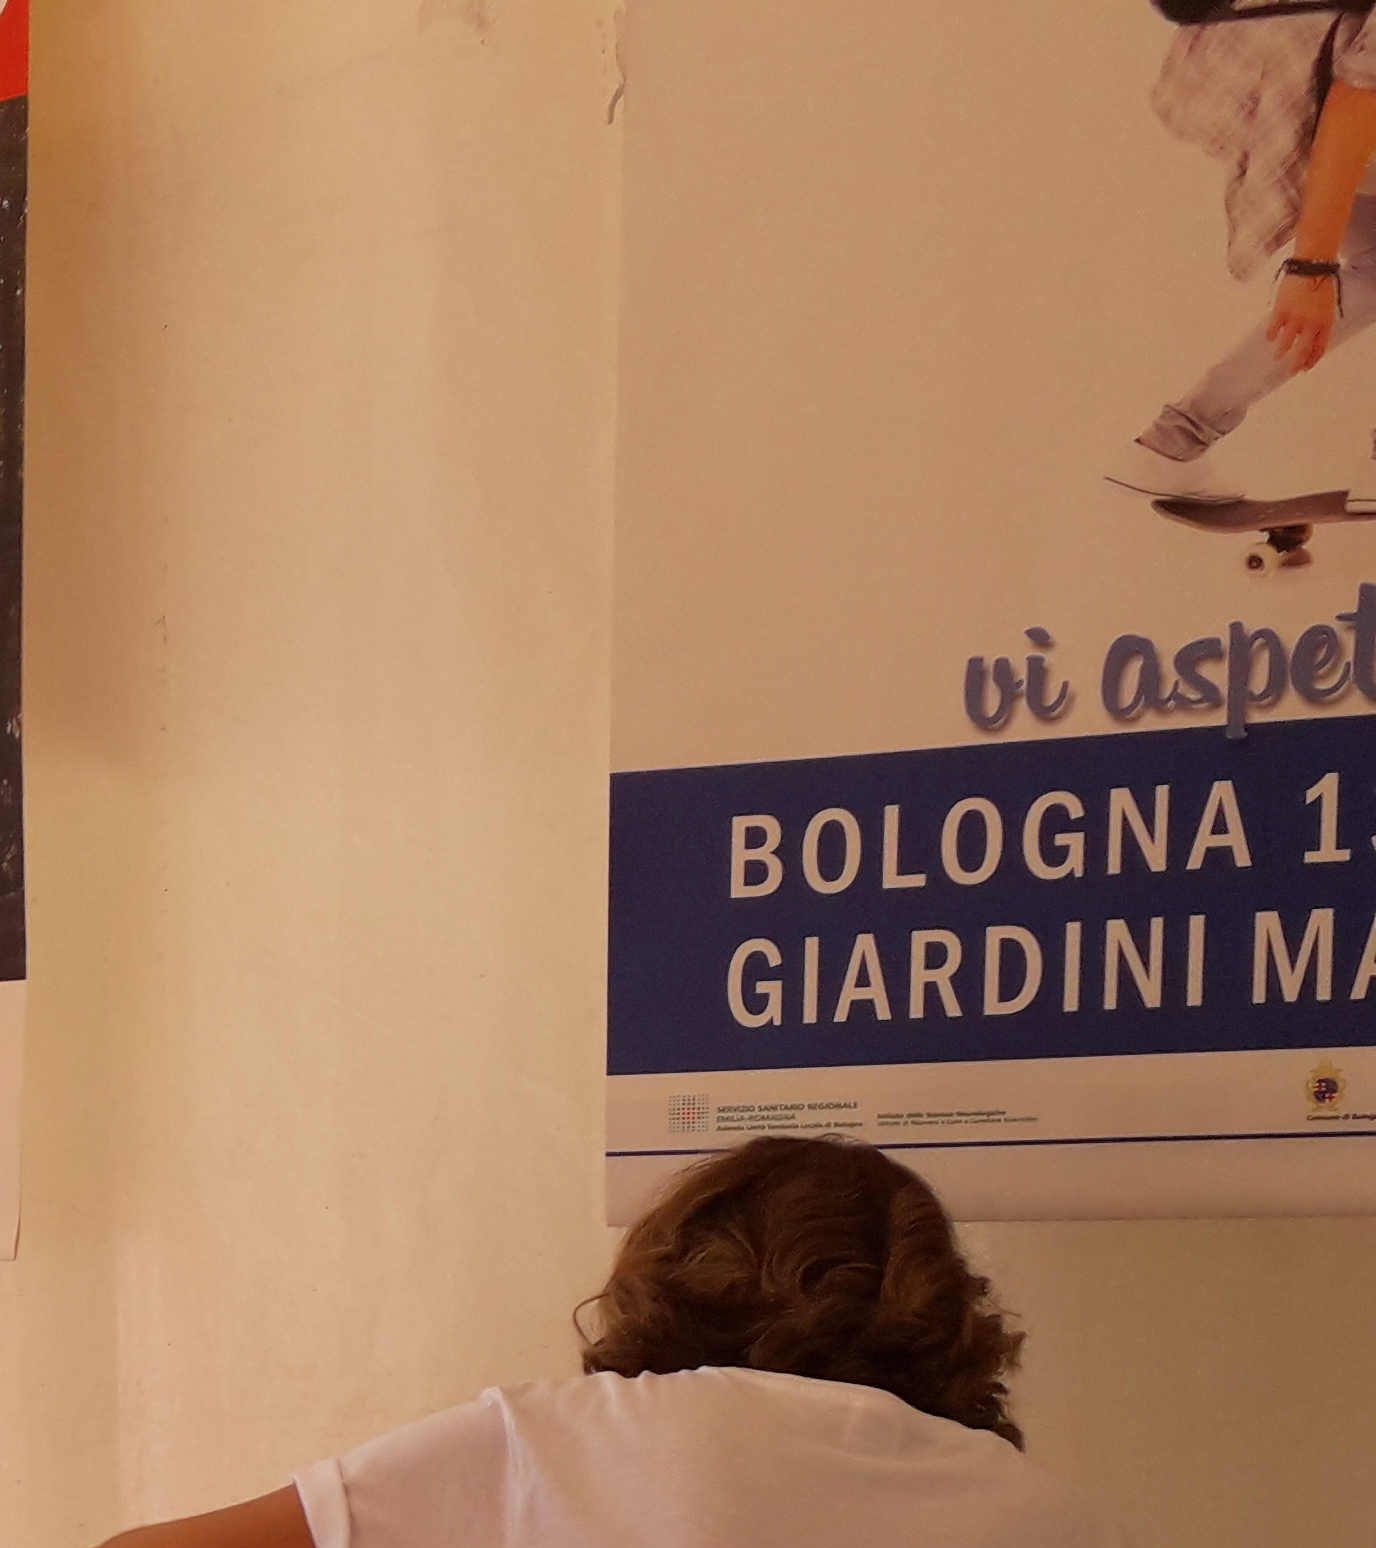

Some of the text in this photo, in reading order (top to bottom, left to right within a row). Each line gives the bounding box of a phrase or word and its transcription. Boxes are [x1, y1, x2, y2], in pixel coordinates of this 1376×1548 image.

[963, 582, 1376, 740] vi aspet
[729, 780, 1253, 899] BOLOGNA
[726, 914, 1206, 1029] GIARDINI
